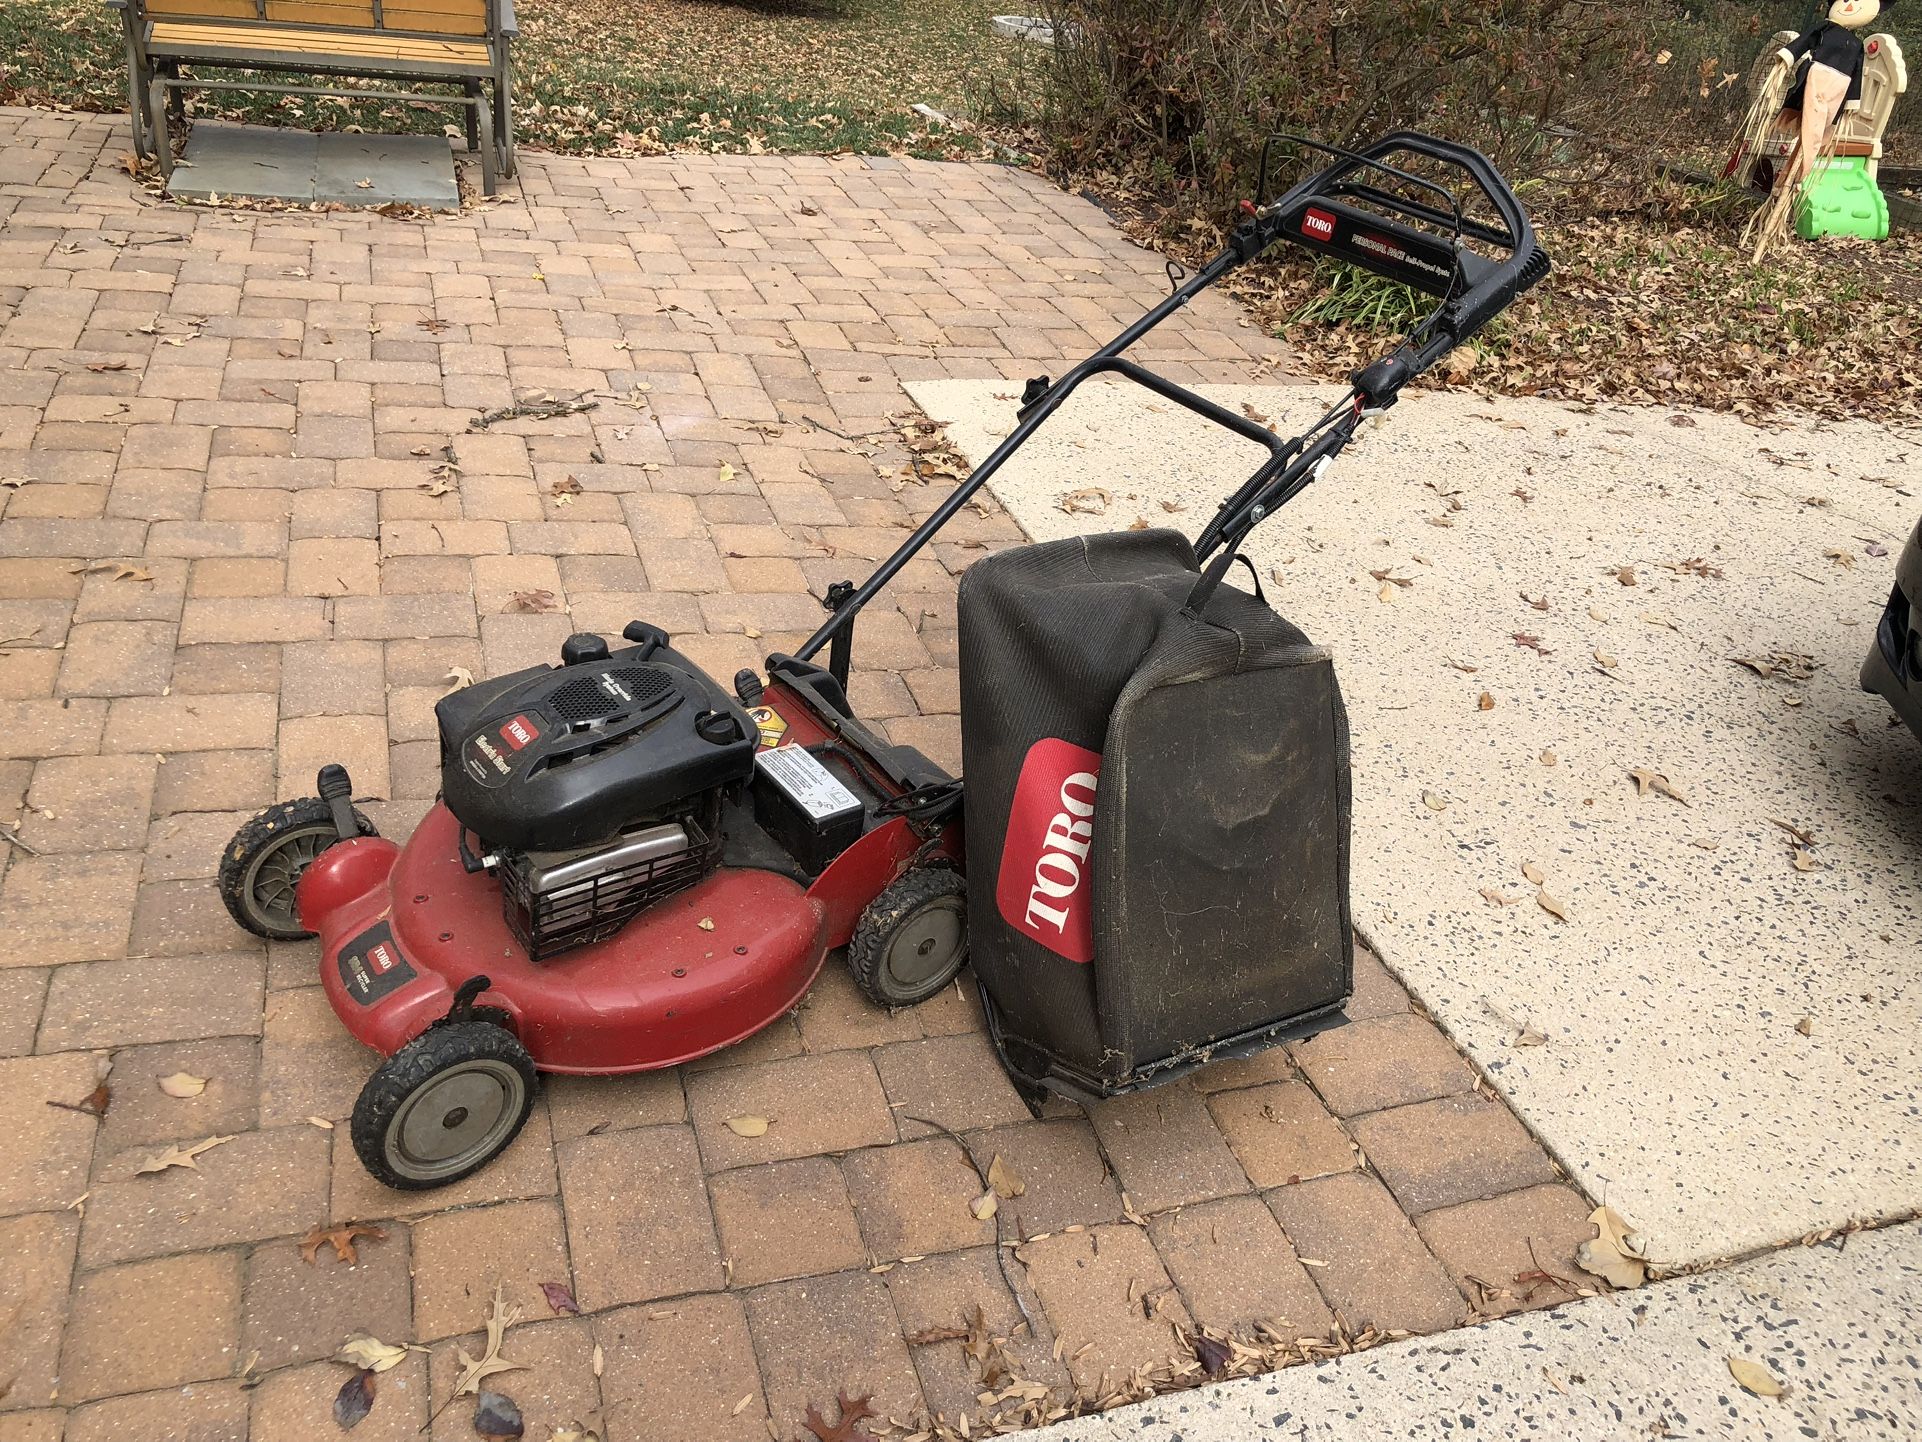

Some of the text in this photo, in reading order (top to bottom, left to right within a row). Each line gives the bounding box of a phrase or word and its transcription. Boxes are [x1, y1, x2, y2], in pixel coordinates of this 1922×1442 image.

[1306, 215, 1332, 233] TORO
[1351, 233, 1386, 255] PERSONAL
[1386, 246, 1406, 261] PACE
[507, 720, 531, 745] TORO
[474, 734, 498, 761] Electric
[492, 755, 512, 776] Start
[1024, 771, 1098, 935] TORO
[374, 945, 393, 969] TORO
